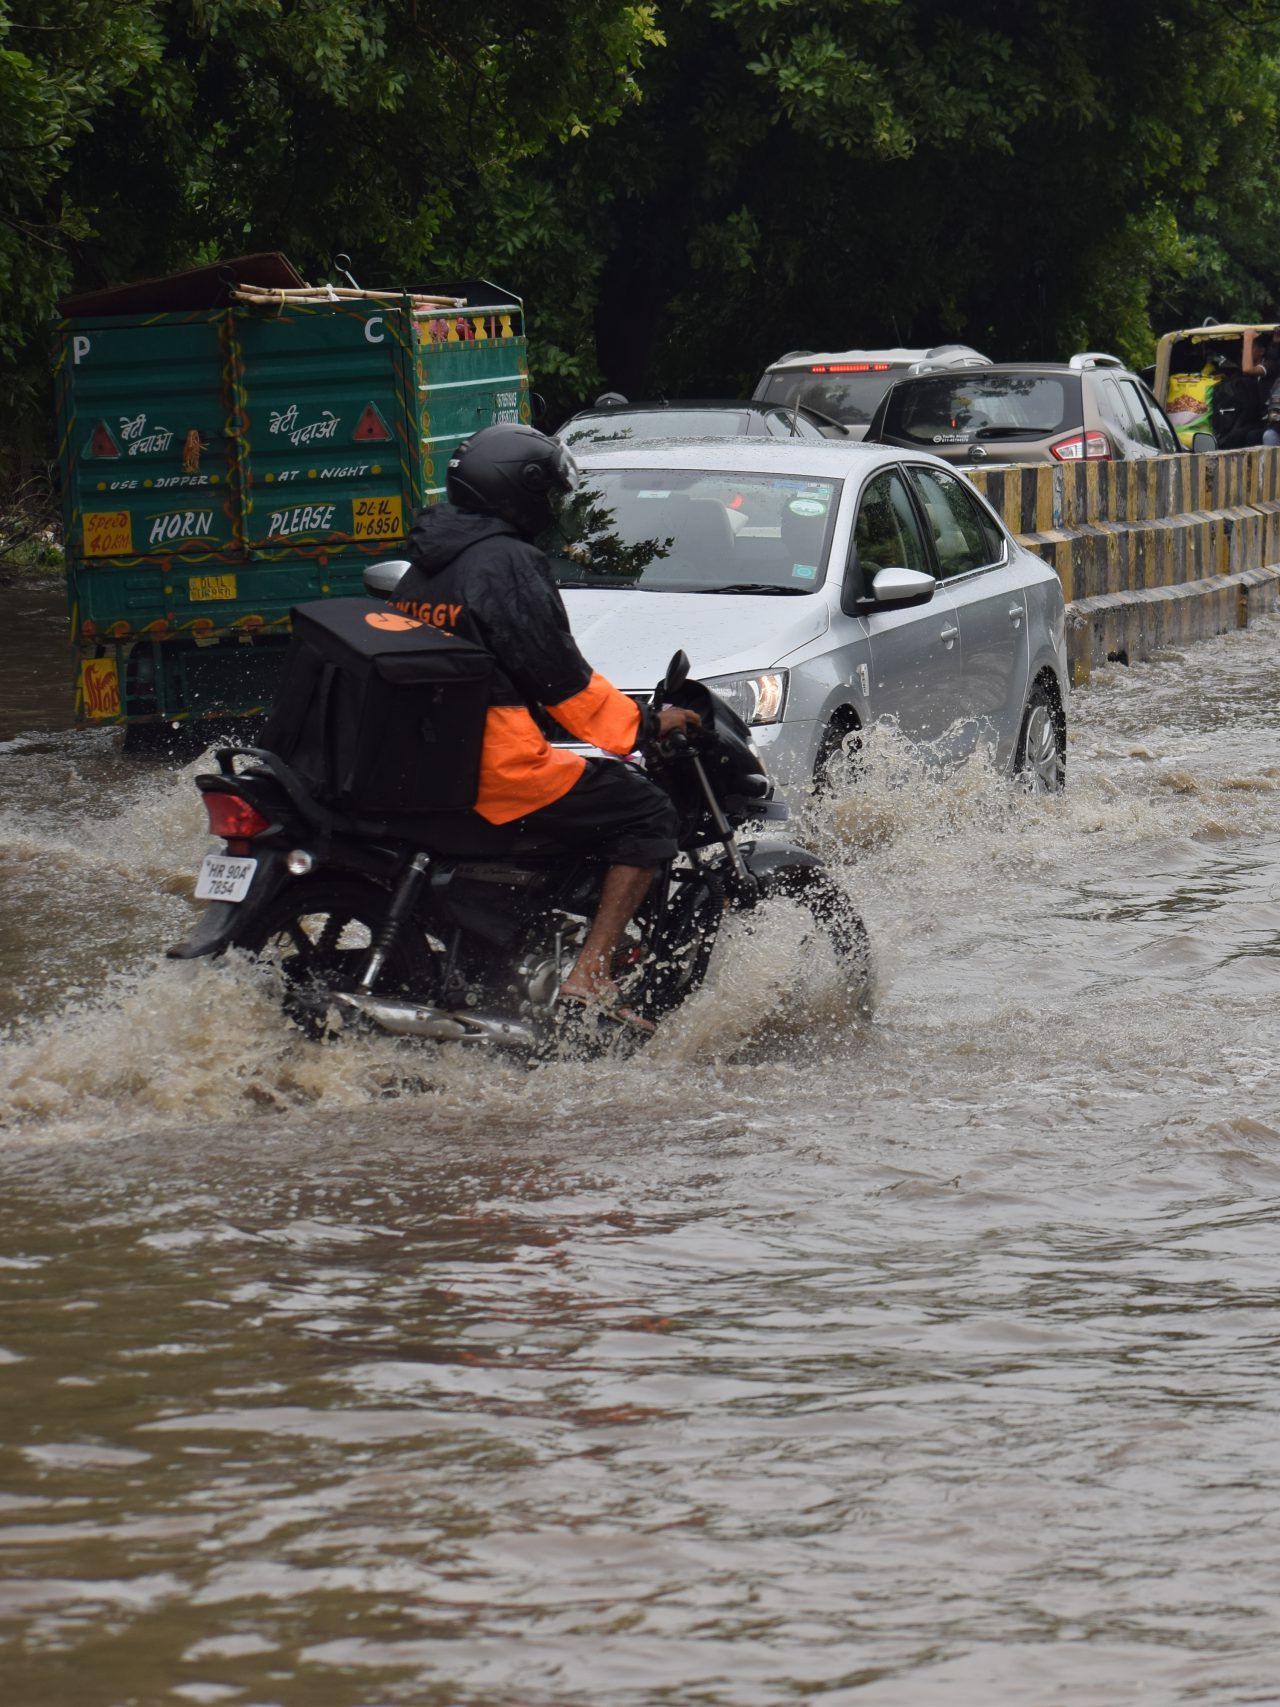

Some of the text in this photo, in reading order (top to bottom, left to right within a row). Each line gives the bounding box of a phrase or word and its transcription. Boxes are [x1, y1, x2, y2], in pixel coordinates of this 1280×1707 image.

[364, 318, 385, 343] C
[73, 336, 91, 365] P
[119, 413, 147, 440] बेटी
[269, 404, 299, 435] बेटी
[288, 410, 341, 446] पढ़ाओ
[128, 426, 174, 456] बचाओ
[110, 465, 369, 490] USE DIPPER AT NIGHT
[149, 506, 336, 545] HORN PLEASE
[387, 601, 463, 628] WIGGY
